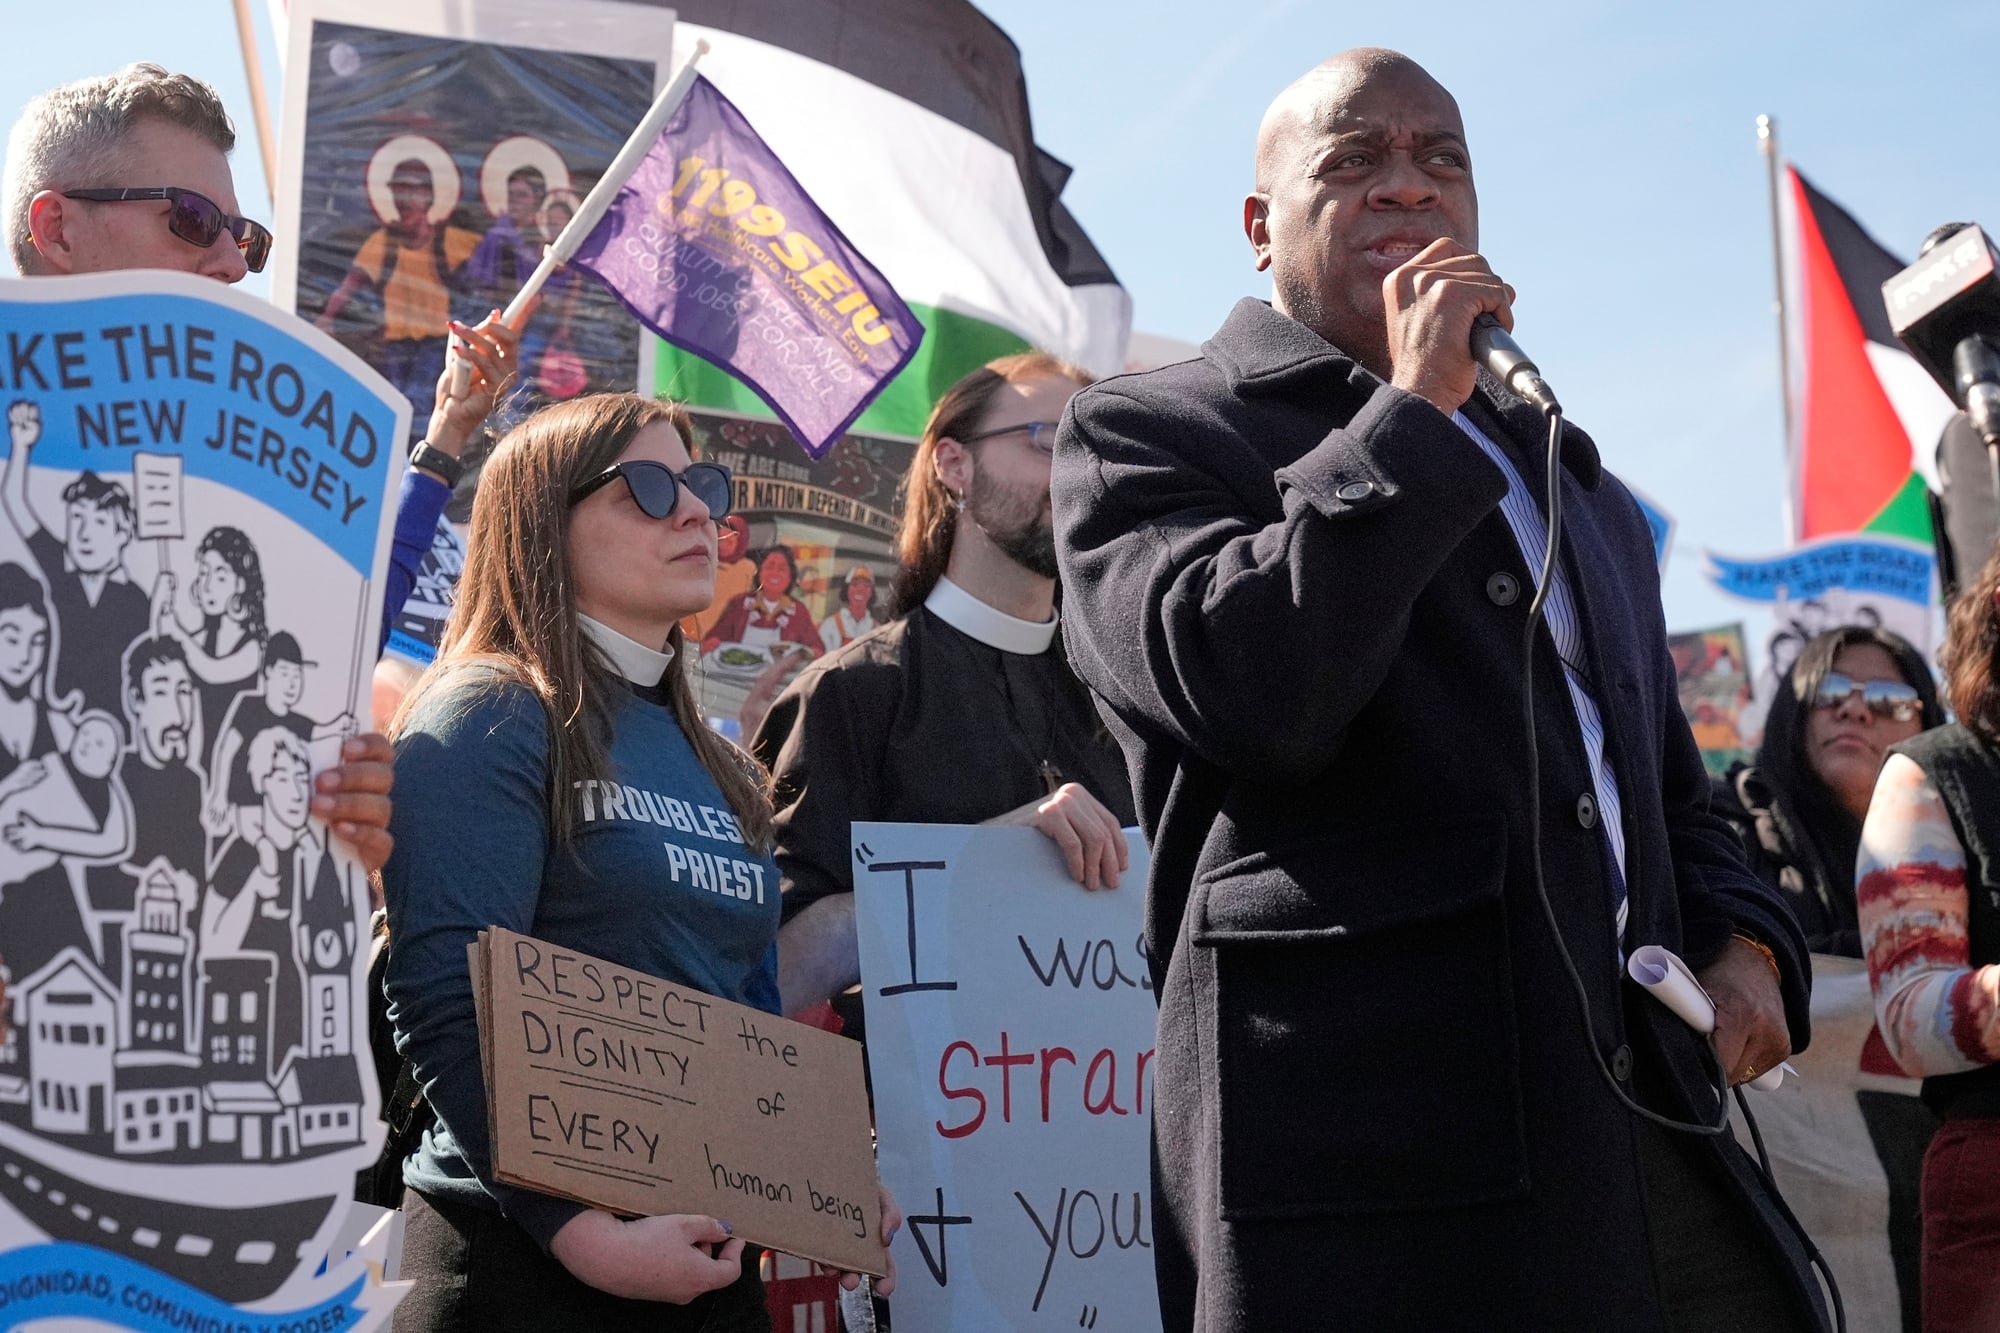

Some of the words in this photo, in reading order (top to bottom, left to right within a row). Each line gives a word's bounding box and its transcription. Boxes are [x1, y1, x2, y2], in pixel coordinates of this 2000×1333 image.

[639, 223, 726, 279] QUALITY
[734, 274, 800, 329] CARE
[802, 336, 853, 383] AND
[671, 156, 892, 345] 1199SEIU
[625, 237, 688, 292] GOOD
[750, 314, 799, 364] FOR
[800, 364, 834, 400] ALL
[783, 270, 842, 331] Workers
[841, 327, 870, 362] East
[0, 331, 92, 391] KE
[102, 323, 216, 384] THE
[229, 339, 377, 469] ROAD
[75, 399, 186, 450] NEW
[205, 409, 367, 525] JERSEY
[747, 454, 775, 477] ARE
[753, 481, 804, 509] NATION
[808, 490, 852, 519] DEPENDS
[573, 779, 753, 847] TROUBLES
[664, 842, 764, 905] PRIEST
[514, 940, 711, 1033] RESPECT
[737, 1017, 798, 1067] the
[522, 1010, 689, 1085] DIGNITY
[756, 1091, 786, 1120] of
[528, 1094, 660, 1165] EVERY
[704, 1143, 792, 1204] human
[808, 1180, 867, 1239] being
[1014, 1186, 1152, 1313] you
